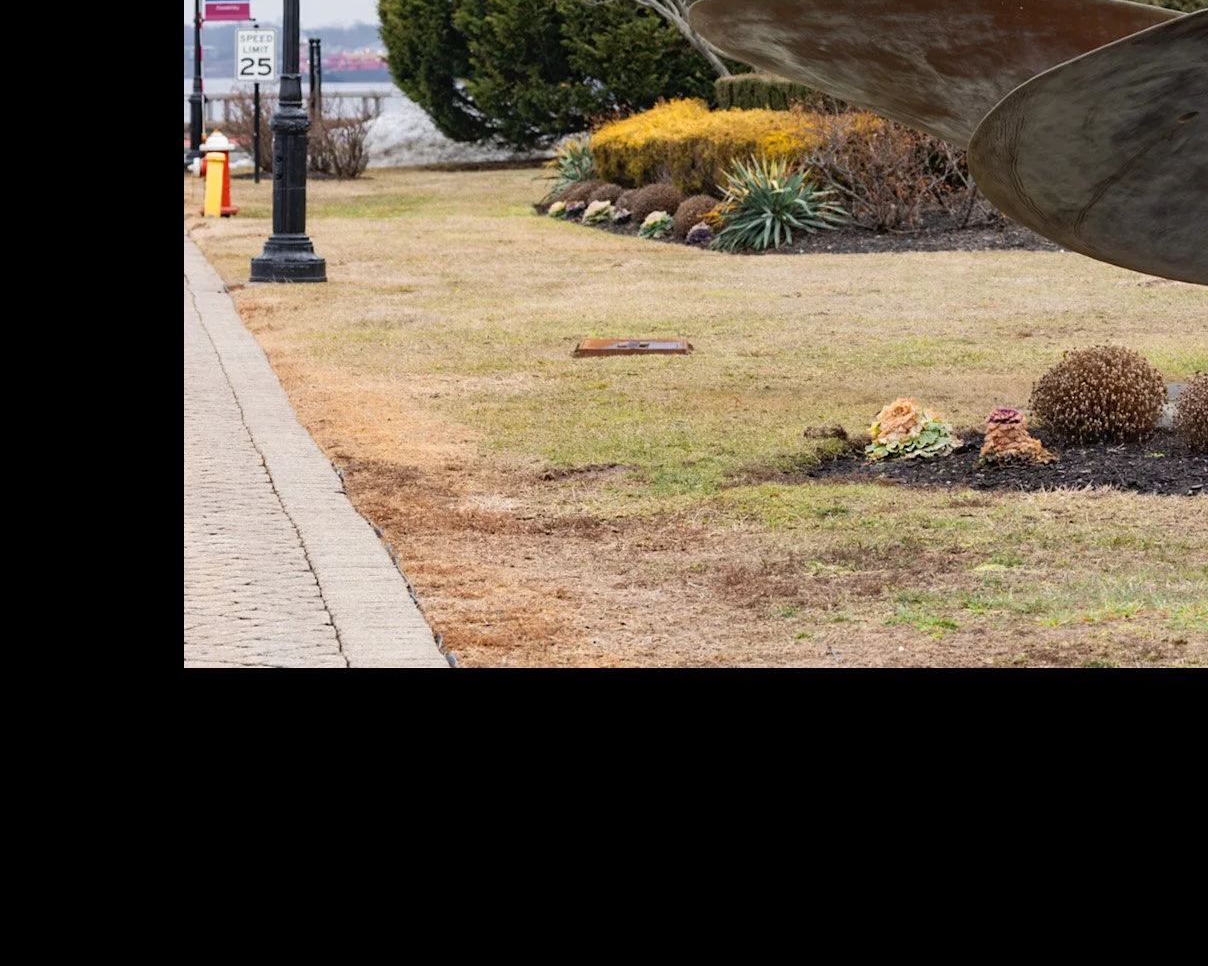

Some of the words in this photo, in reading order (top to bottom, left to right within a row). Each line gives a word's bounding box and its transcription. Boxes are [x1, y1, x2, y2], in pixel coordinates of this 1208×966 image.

[240, 35, 273, 43] SPEED
[242, 46, 269, 54] LIMIT
[240, 57, 272, 76] 25
